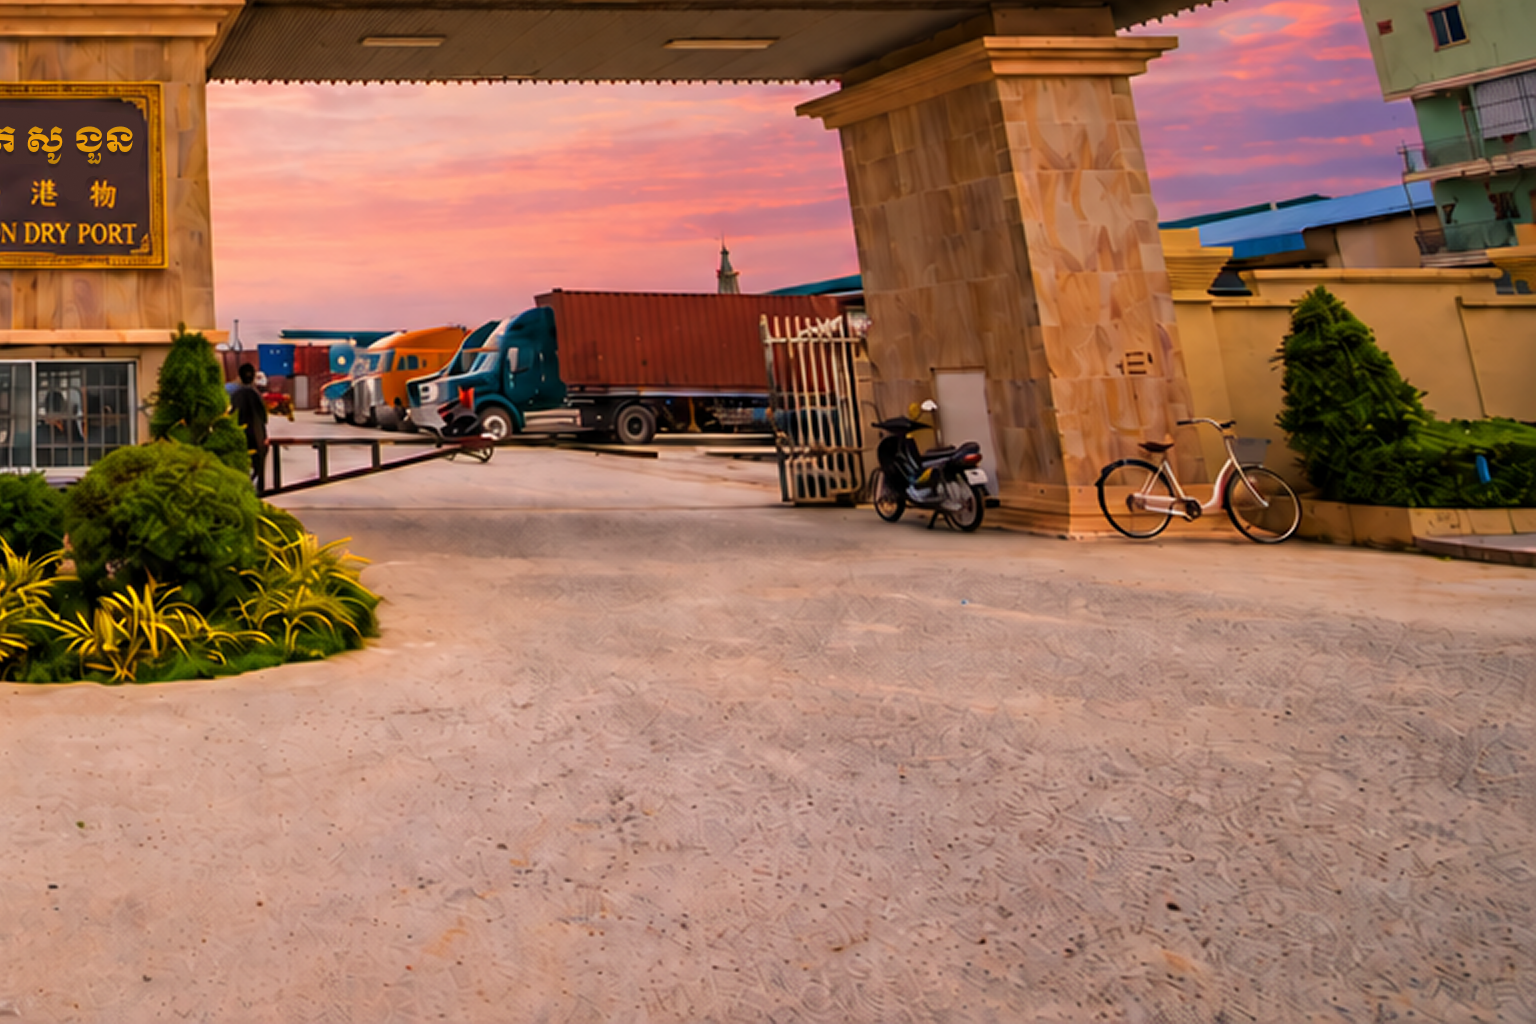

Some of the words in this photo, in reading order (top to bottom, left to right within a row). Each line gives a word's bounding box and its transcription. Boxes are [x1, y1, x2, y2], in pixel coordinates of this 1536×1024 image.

[27, 126, 63, 165] សូ
[24, 222, 71, 244] DRY
[78, 223, 137, 245] PORT
